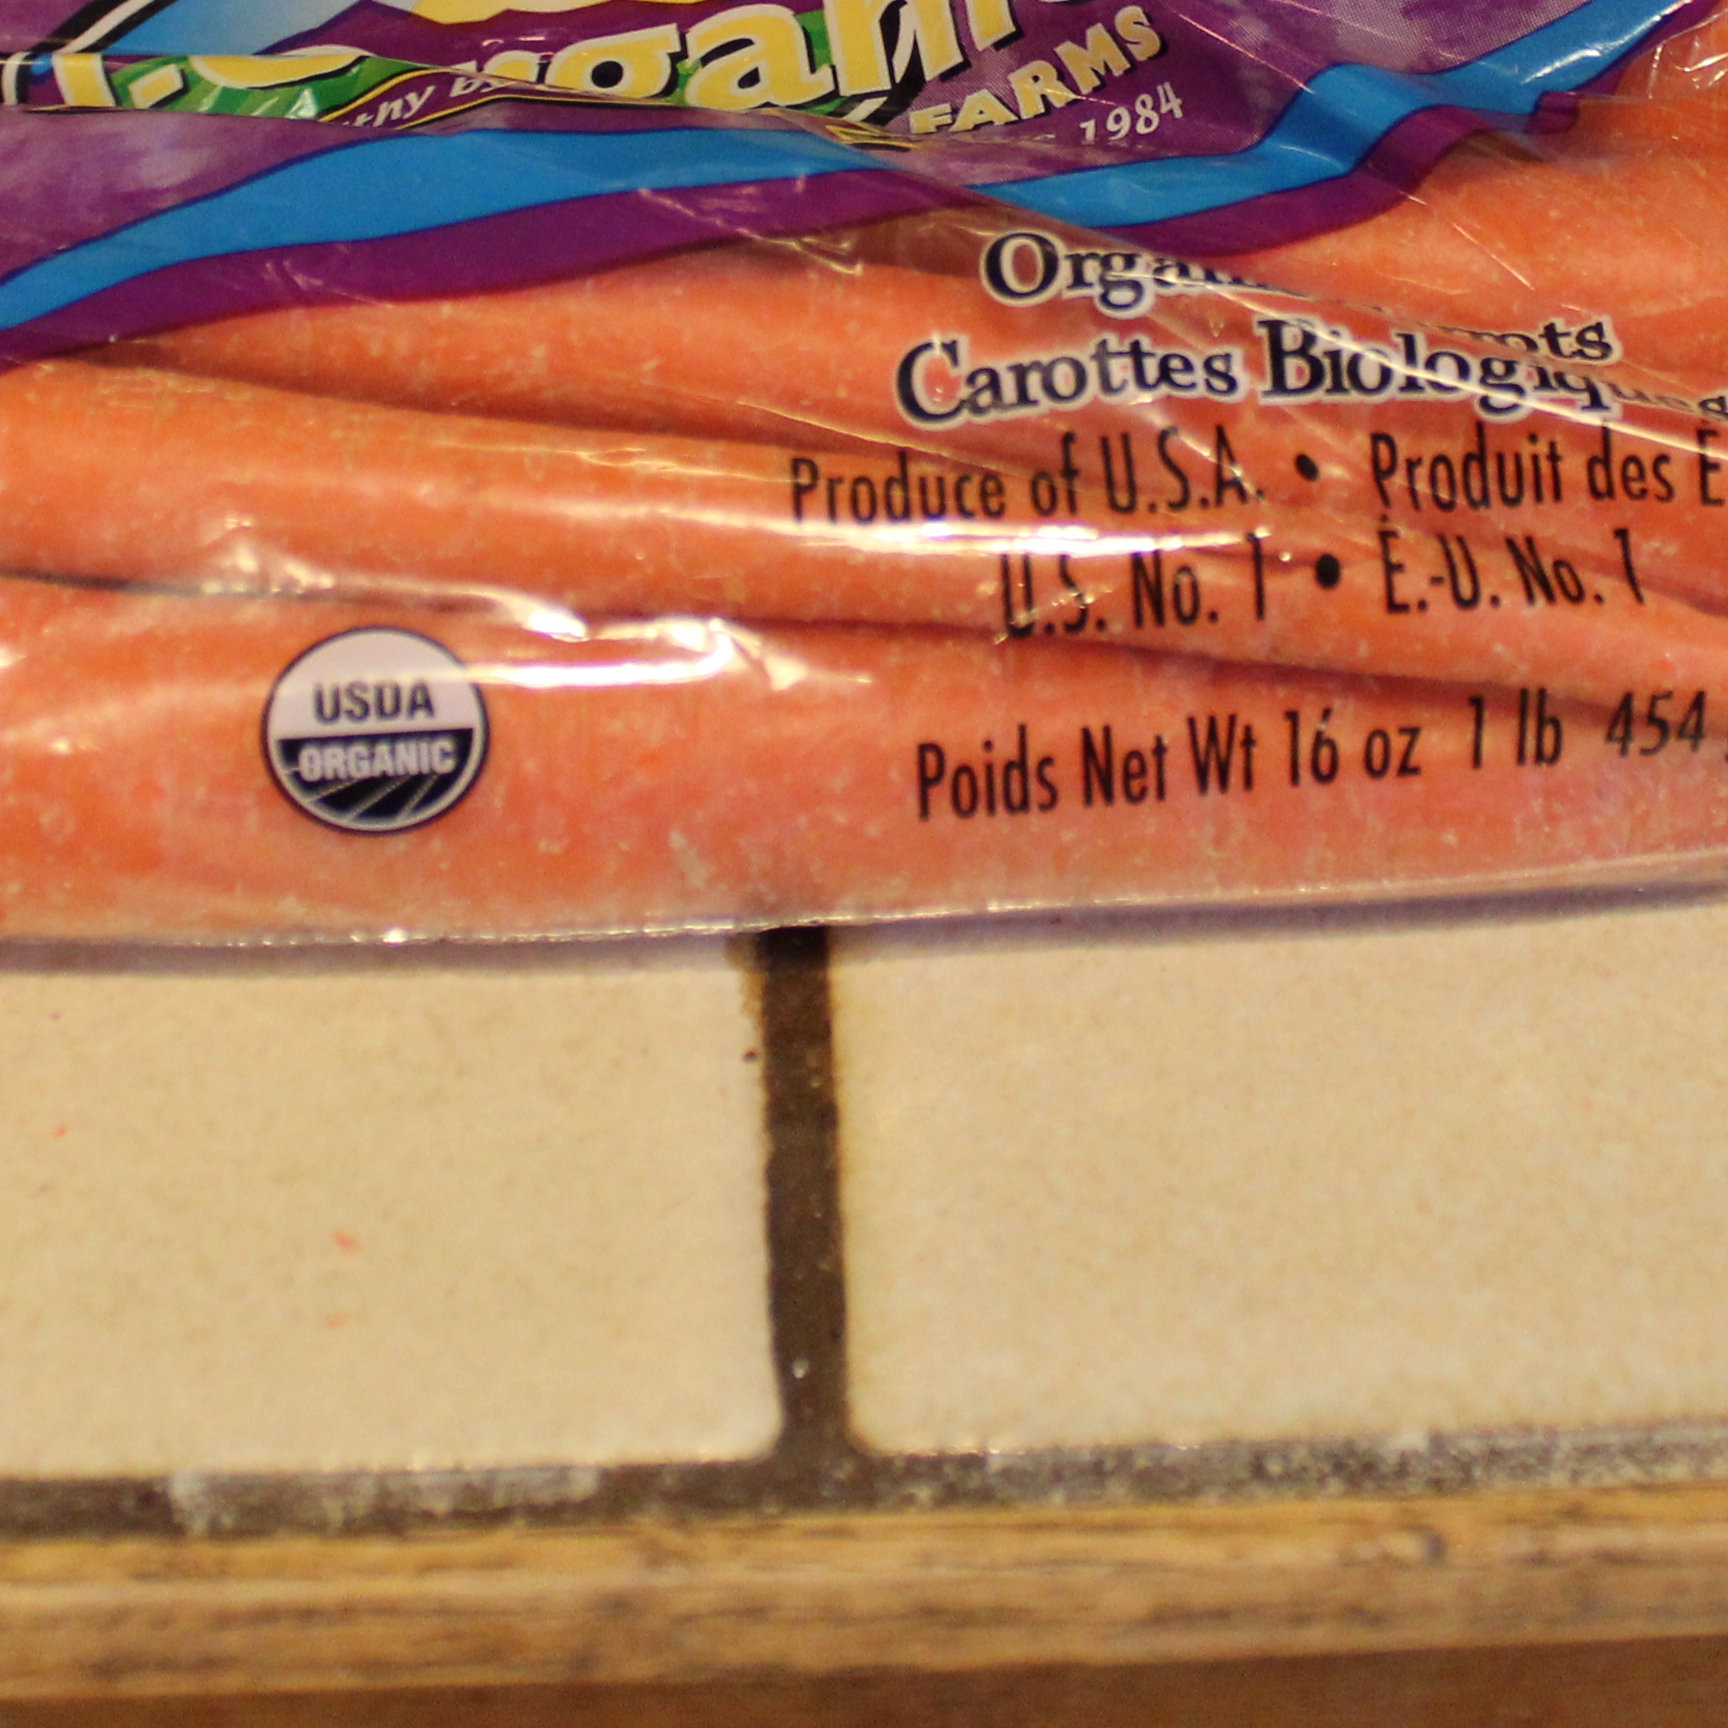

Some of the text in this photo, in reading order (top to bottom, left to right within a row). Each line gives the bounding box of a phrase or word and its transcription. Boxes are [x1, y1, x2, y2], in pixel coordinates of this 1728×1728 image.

[909, 5, 1163, 135] FARMS
[1080, 81, 1184, 145] 1984
[899, 339, 1236, 424] Carottes
[790, 457, 1006, 525] Produce
[1029, 430, 1082, 516] of
[1103, 425, 1266, 514] U.S.A.
[1371, 430, 1564, 513] Produit
[1586, 422, 1674, 503] des
[1002, 550, 1108, 639] U.S.
[1133, 540, 1219, 630] No.
[1250, 534, 1269, 624] 1
[1517, 534, 1605, 606] No.
[1611, 528, 1648, 606] 1
[314, 679, 436, 723] USDA
[298, 733, 458, 783] ORGANIC
[916, 723, 1060, 823] Poids
[1080, 723, 1168, 807] Net
[1187, 713, 1259, 794] Wt
[1284, 705, 1340, 787] 16
[1362, 724, 1423, 780] oz
[1466, 695, 1486, 769] 1
[1515, 686, 1565, 766] lb
[1603, 689, 1708, 758] 454
